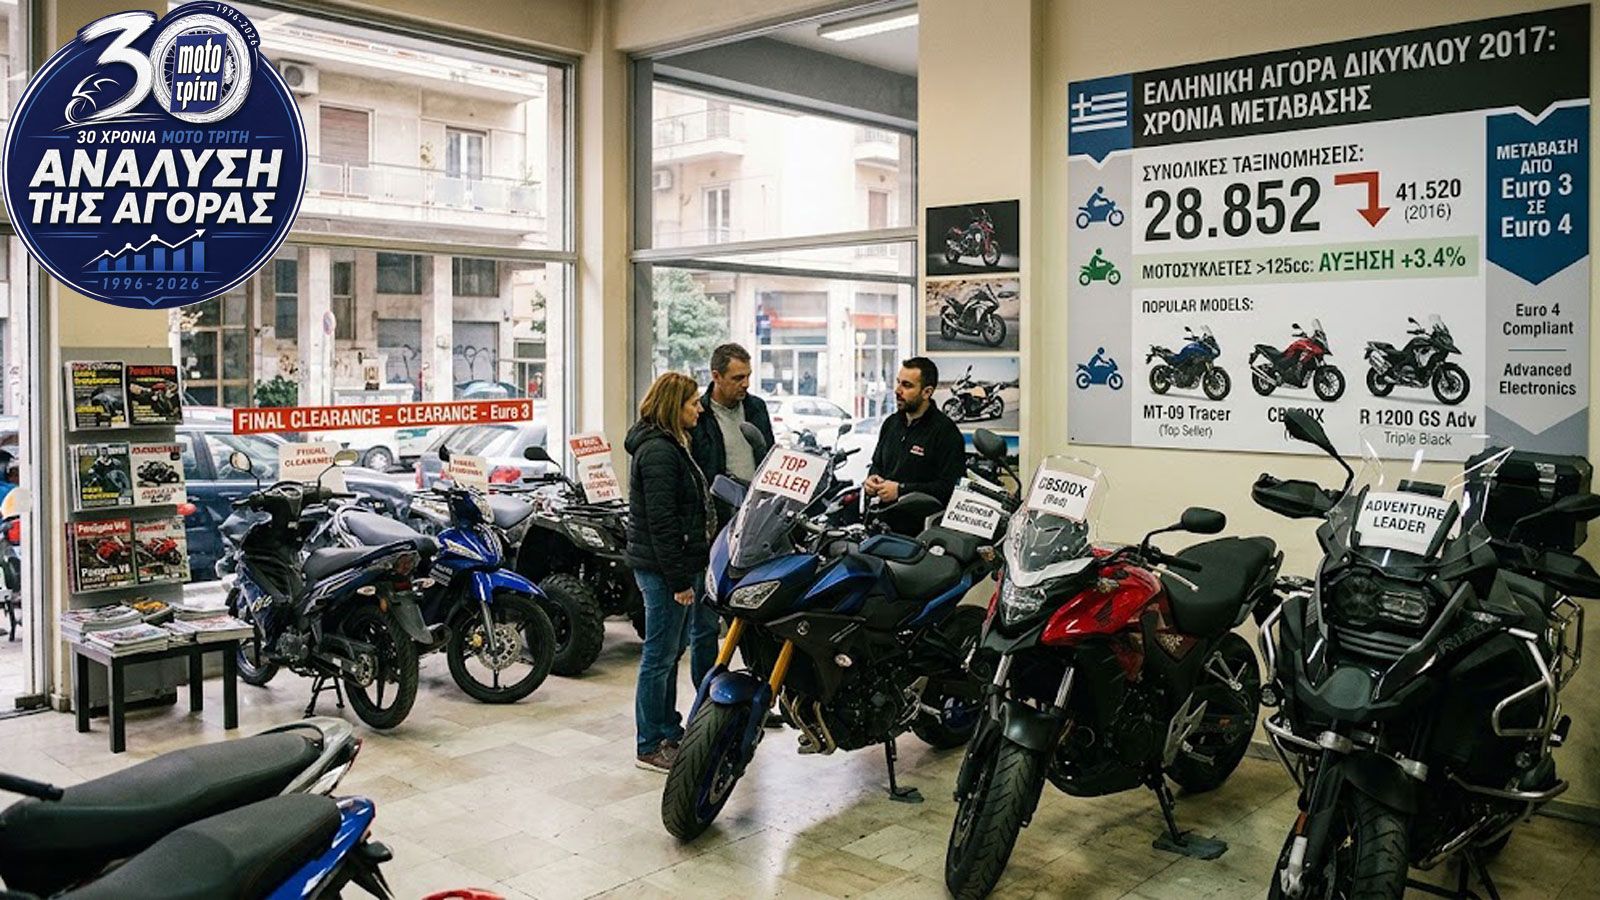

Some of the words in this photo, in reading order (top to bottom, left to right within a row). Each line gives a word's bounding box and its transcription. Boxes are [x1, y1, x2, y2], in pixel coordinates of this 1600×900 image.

[1143, 67, 1253, 105] ΕΛΛΗΝΙΚΗ
[1260, 56, 1337, 90] ΑΓΟΡΑ
[1343, 35, 1472, 78] ΔΙΚΥΚΛΟΥ
[1479, 25, 1556, 60] 2017:
[1142, 104, 1224, 136] ΧΡΟΝΙΑ
[1230, 84, 1372, 126] ΜΕΤΑΒΑΣΗΣ
[1496, 138, 1578, 160] ΜΕΤΑΒΑΣΗ
[1142, 157, 1228, 182] ΣΥΝΟΛΙΚΕΣ
[1232, 144, 1365, 173] ΤΑΞΙΝΟΜΗΣΕΙΣ:
[1520, 158, 1553, 174] ΑΠΟ
[1395, 178, 1462, 201] 41.520
[1502, 177, 1551, 199] Euro
[1558, 173, 1573, 195] 3
[1144, 176, 1321, 242] 28.852
[1404, 203, 1451, 223] (2016)
[1526, 199, 1546, 214] ΣΕ
[1501, 216, 1551, 238] Euro
[1557, 213, 1573, 235] 4
[1142, 259, 1252, 280] ΜΟΤΟΣΥΚΛΕΤΕΣ
[1256, 257, 1314, 275] >125cc:
[1319, 249, 1394, 272] ΑΥΞΗΣΗ
[1401, 246, 1466, 269] +3.4%
[1200, 297, 1254, 312] MODELS:
[1516, 303, 1547, 317] Euro
[1551, 302, 1561, 316] 4
[1502, 321, 1574, 338] Compliant
[1503, 362, 1572, 376] Advanced
[1499, 380, 1577, 395] Electronics
[238, 411, 286, 431] FINAL
[290, 407, 381, 429] CLEARANCE
[397, 404, 478, 425] CLEARANCE
[521, 402, 530, 419] 3
[1143, 404, 1185, 420] MT-09
[1188, 404, 1231, 421] Tracer
[1360, 408, 1370, 425] R
[1376, 409, 1414, 426] 1200
[1419, 410, 1441, 428] GS
[1446, 411, 1477, 428] Adv
[1158, 423, 1181, 438] (Top
[1182, 423, 1213, 439] Seller)
[1384, 430, 1416, 446] Triple
[1419, 432, 1453, 446] Black
[780, 454, 808, 472] TOP
[761, 470, 811, 495] SELLER
[1038, 476, 1088, 498] CB500X
[1364, 499, 1446, 521] ADVENTURE
[1373, 516, 1426, 534] LEADER
